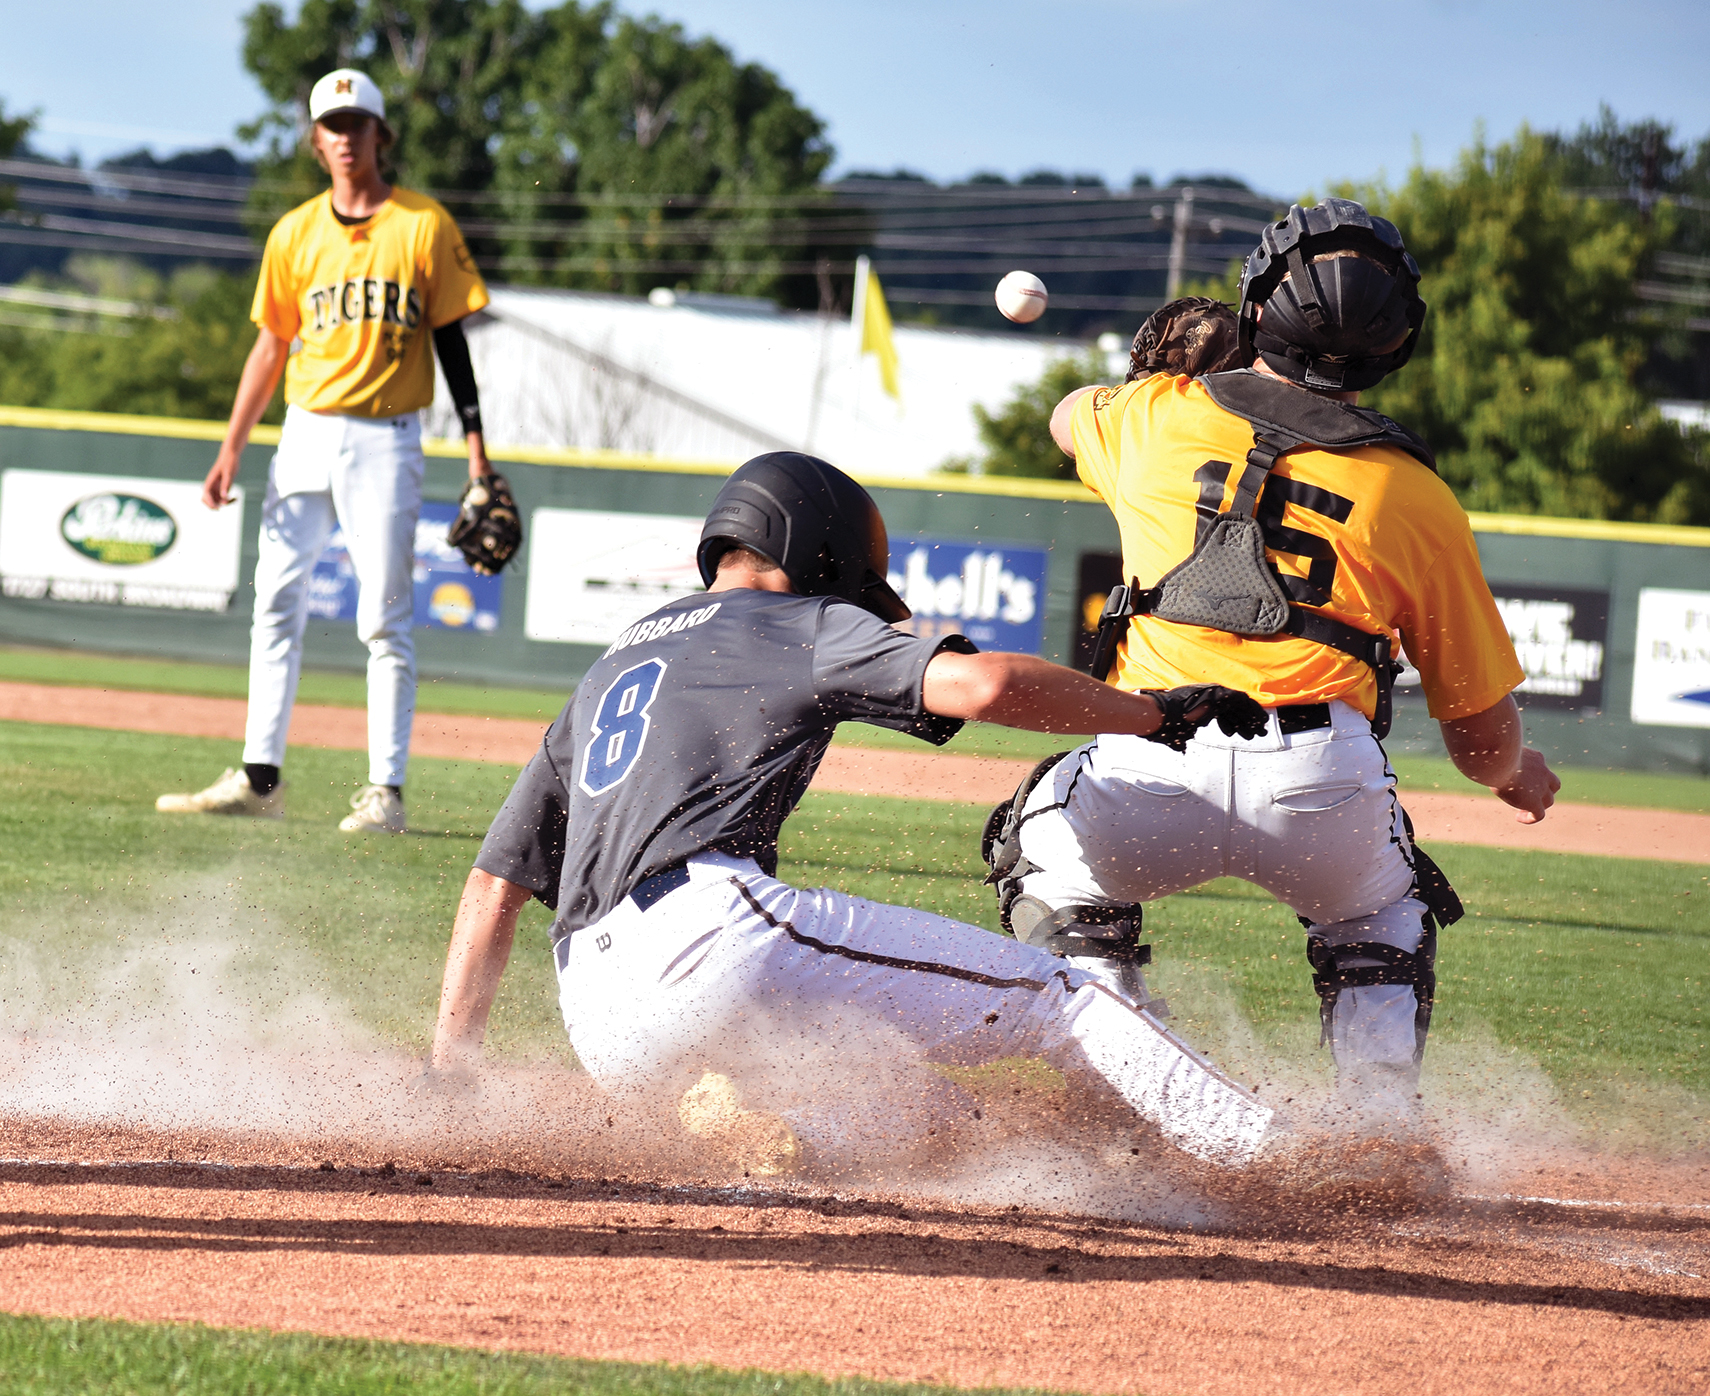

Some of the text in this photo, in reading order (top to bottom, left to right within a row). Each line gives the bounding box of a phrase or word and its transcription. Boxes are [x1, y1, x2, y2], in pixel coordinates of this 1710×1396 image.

[310, 279, 421, 332] TIGERS
[1193, 459, 1356, 608] 15
[602, 602, 722, 660] HUBBARD
[578, 656, 669, 798] 8
